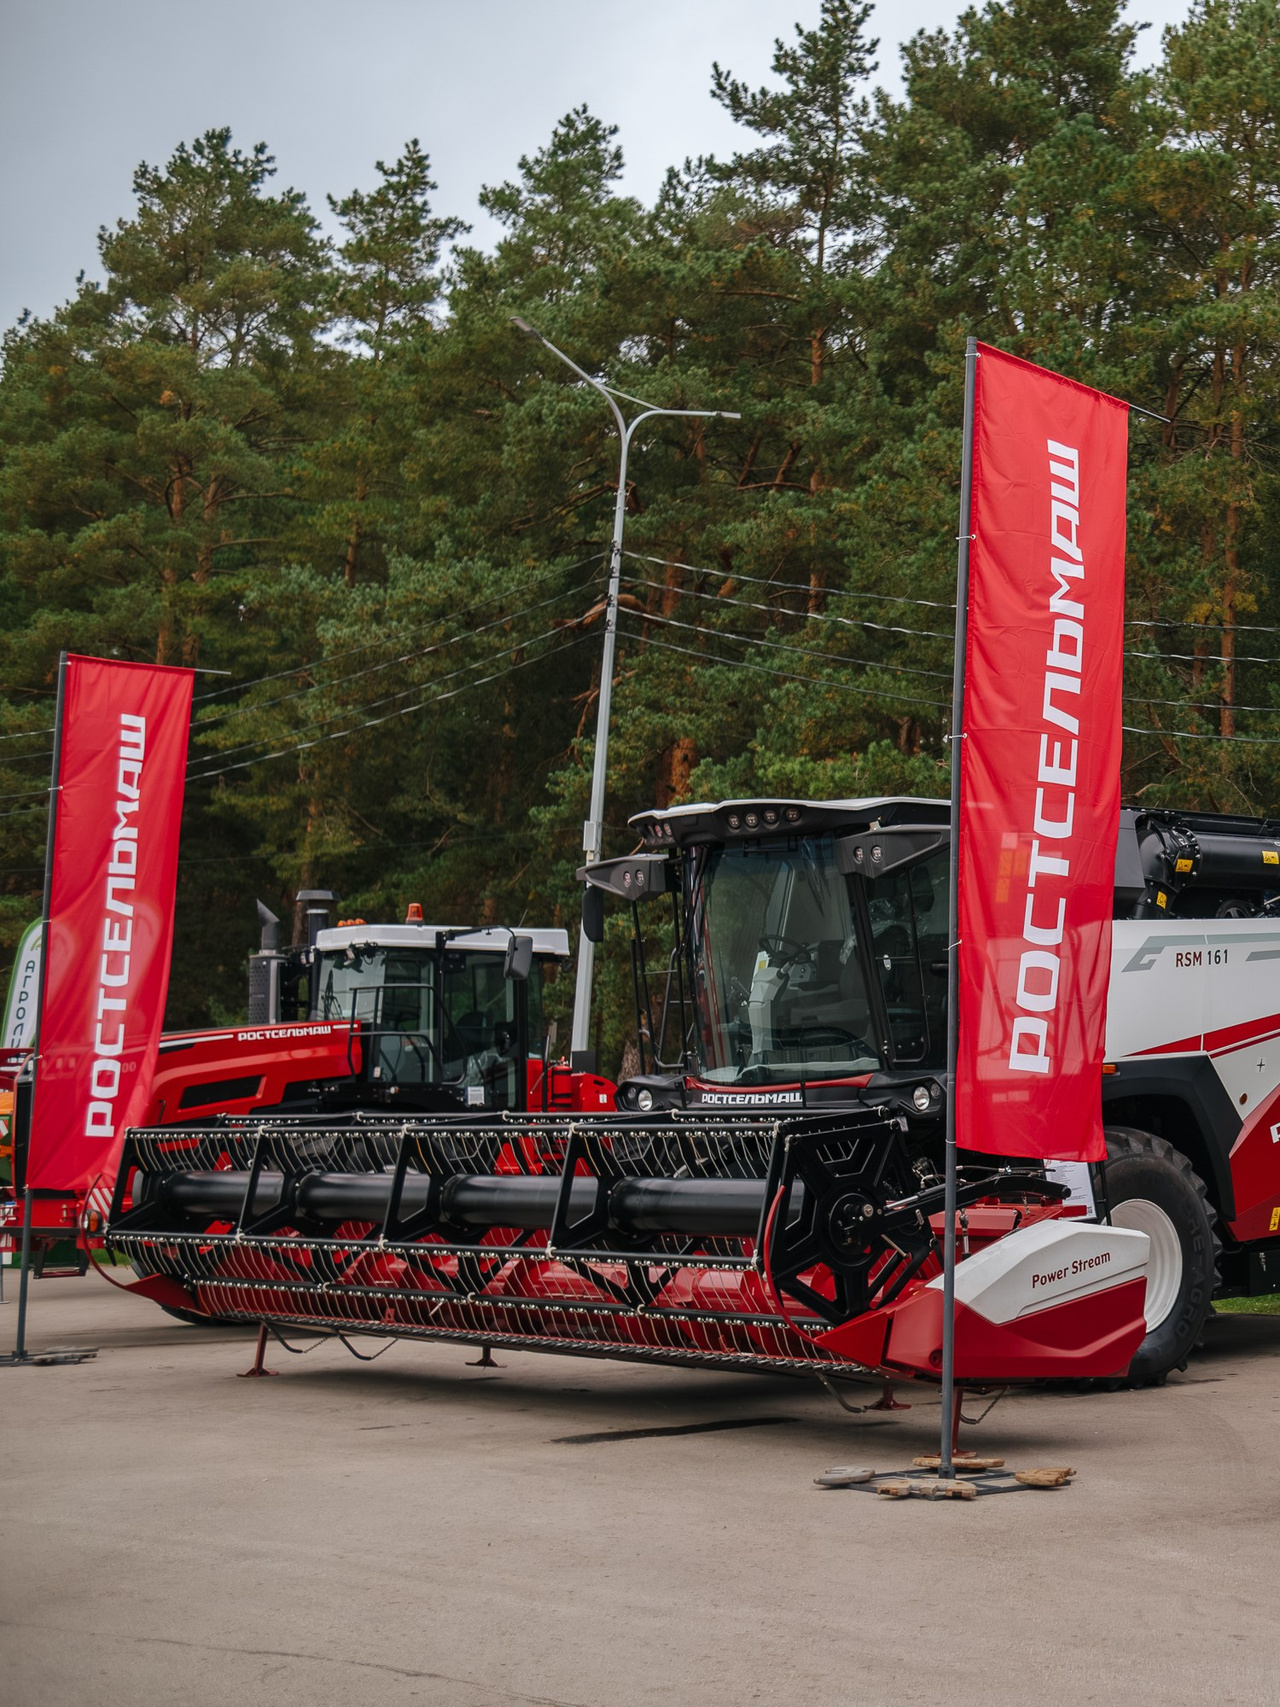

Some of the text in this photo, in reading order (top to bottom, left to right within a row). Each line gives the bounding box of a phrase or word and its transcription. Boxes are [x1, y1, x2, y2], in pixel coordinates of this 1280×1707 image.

[1008, 438, 1085, 1074] РОСТСЕЛЬМАШ
[84, 713, 146, 1138] РОСТСЕЛЬМАШ
[1175, 949, 1228, 967] RSM 161
[238, 1025, 331, 1041] РОСТСЕЛЬМАШ
[1032, 1252, 1111, 1289] Power Stream
